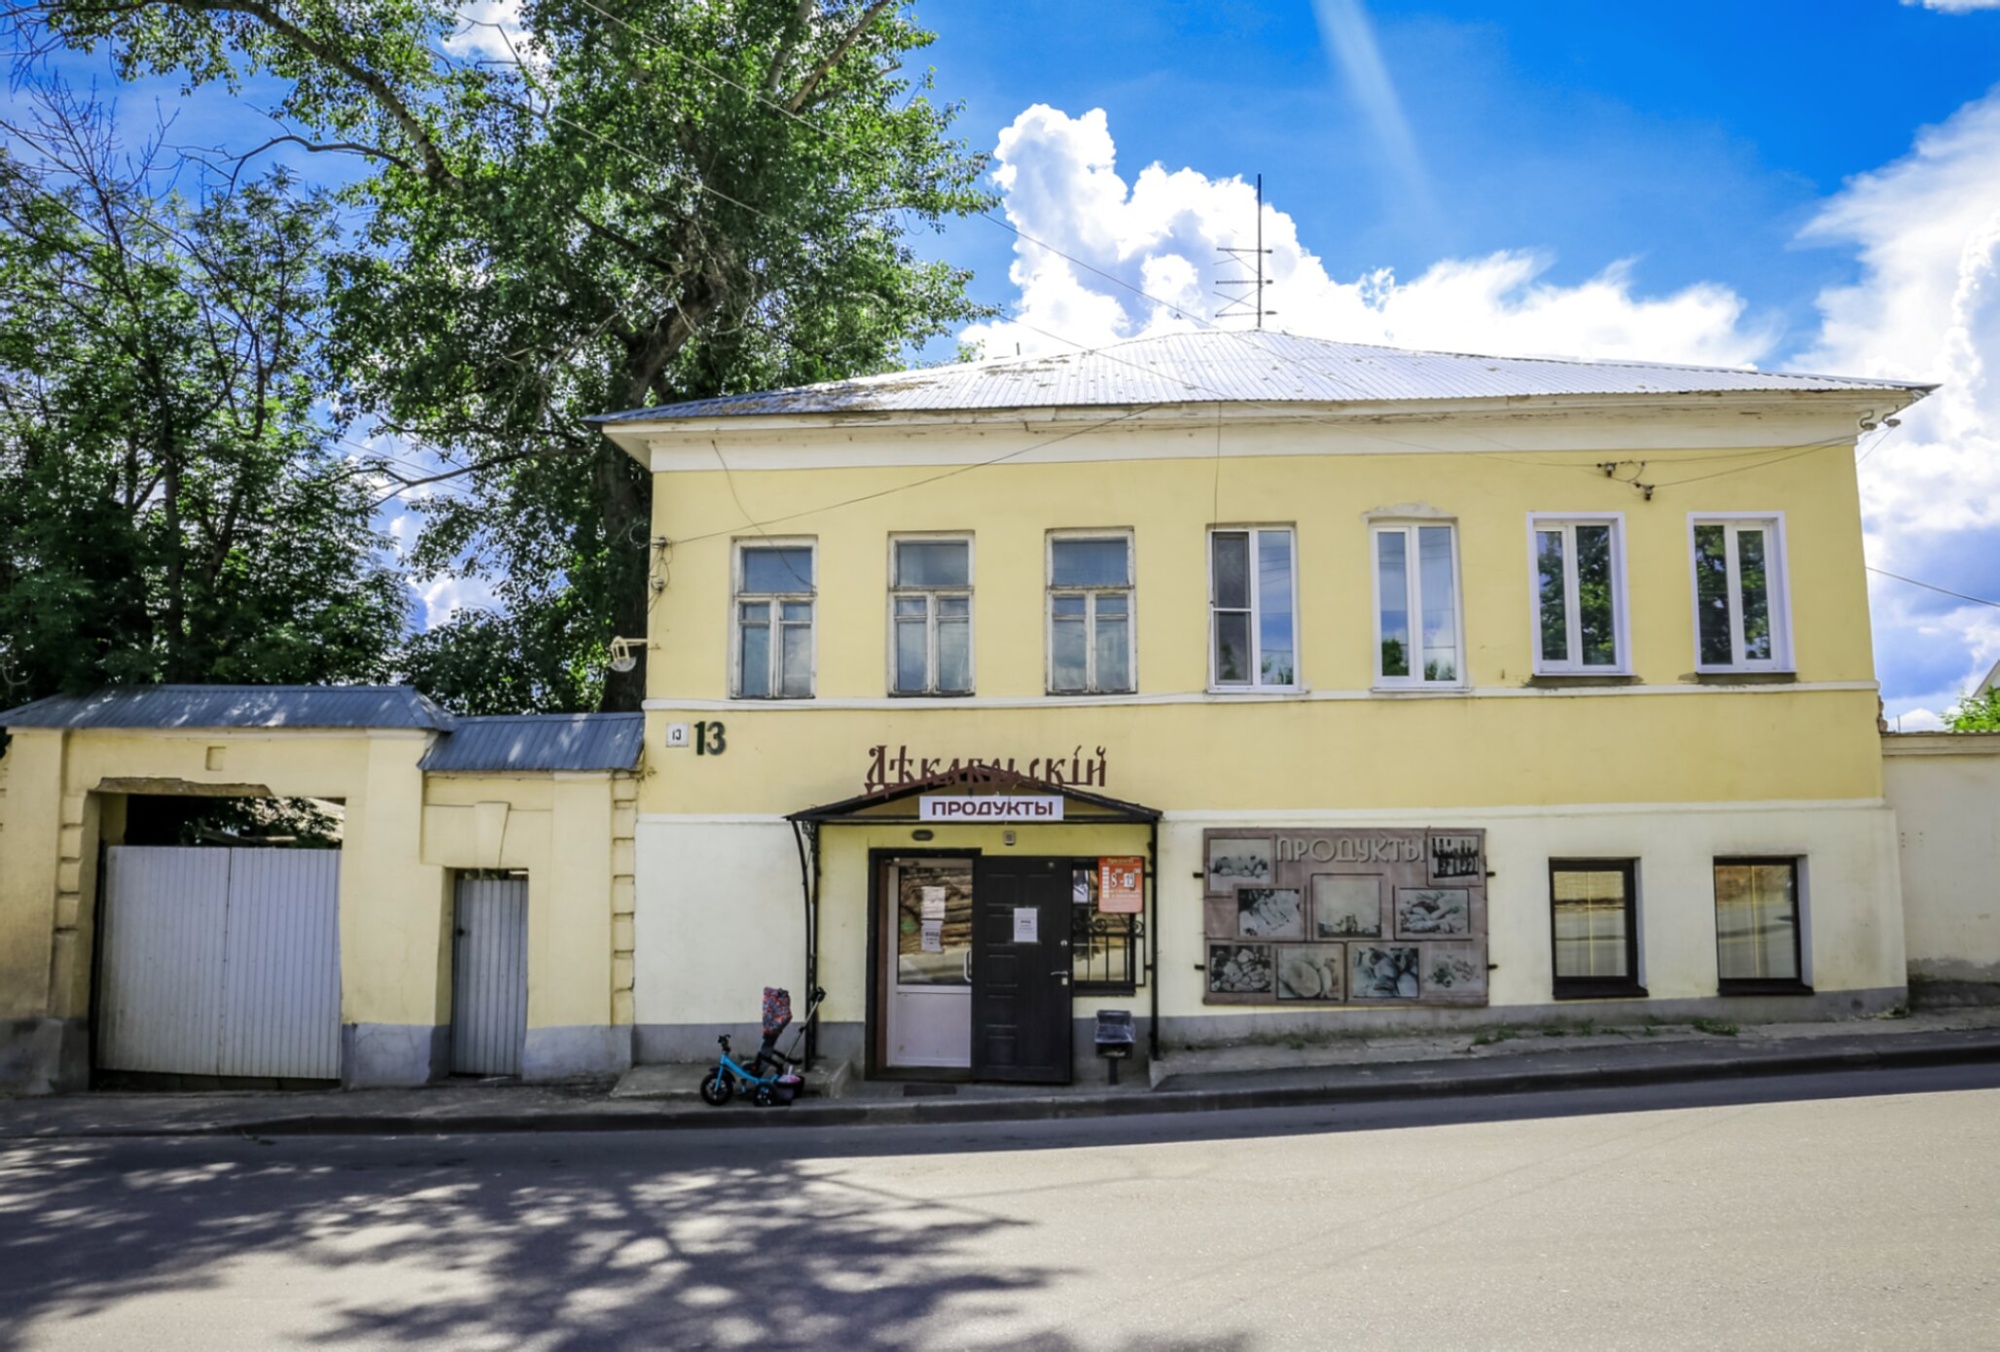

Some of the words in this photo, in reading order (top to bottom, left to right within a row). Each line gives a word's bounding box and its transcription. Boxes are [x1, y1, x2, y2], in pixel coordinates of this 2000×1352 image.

[672, 728, 682, 741] 13
[694, 721, 727, 755] 13
[932, 801, 1053, 816] ПРОДУКТЫ
[1277, 838, 1427, 863] ПРОДУКТЫ
